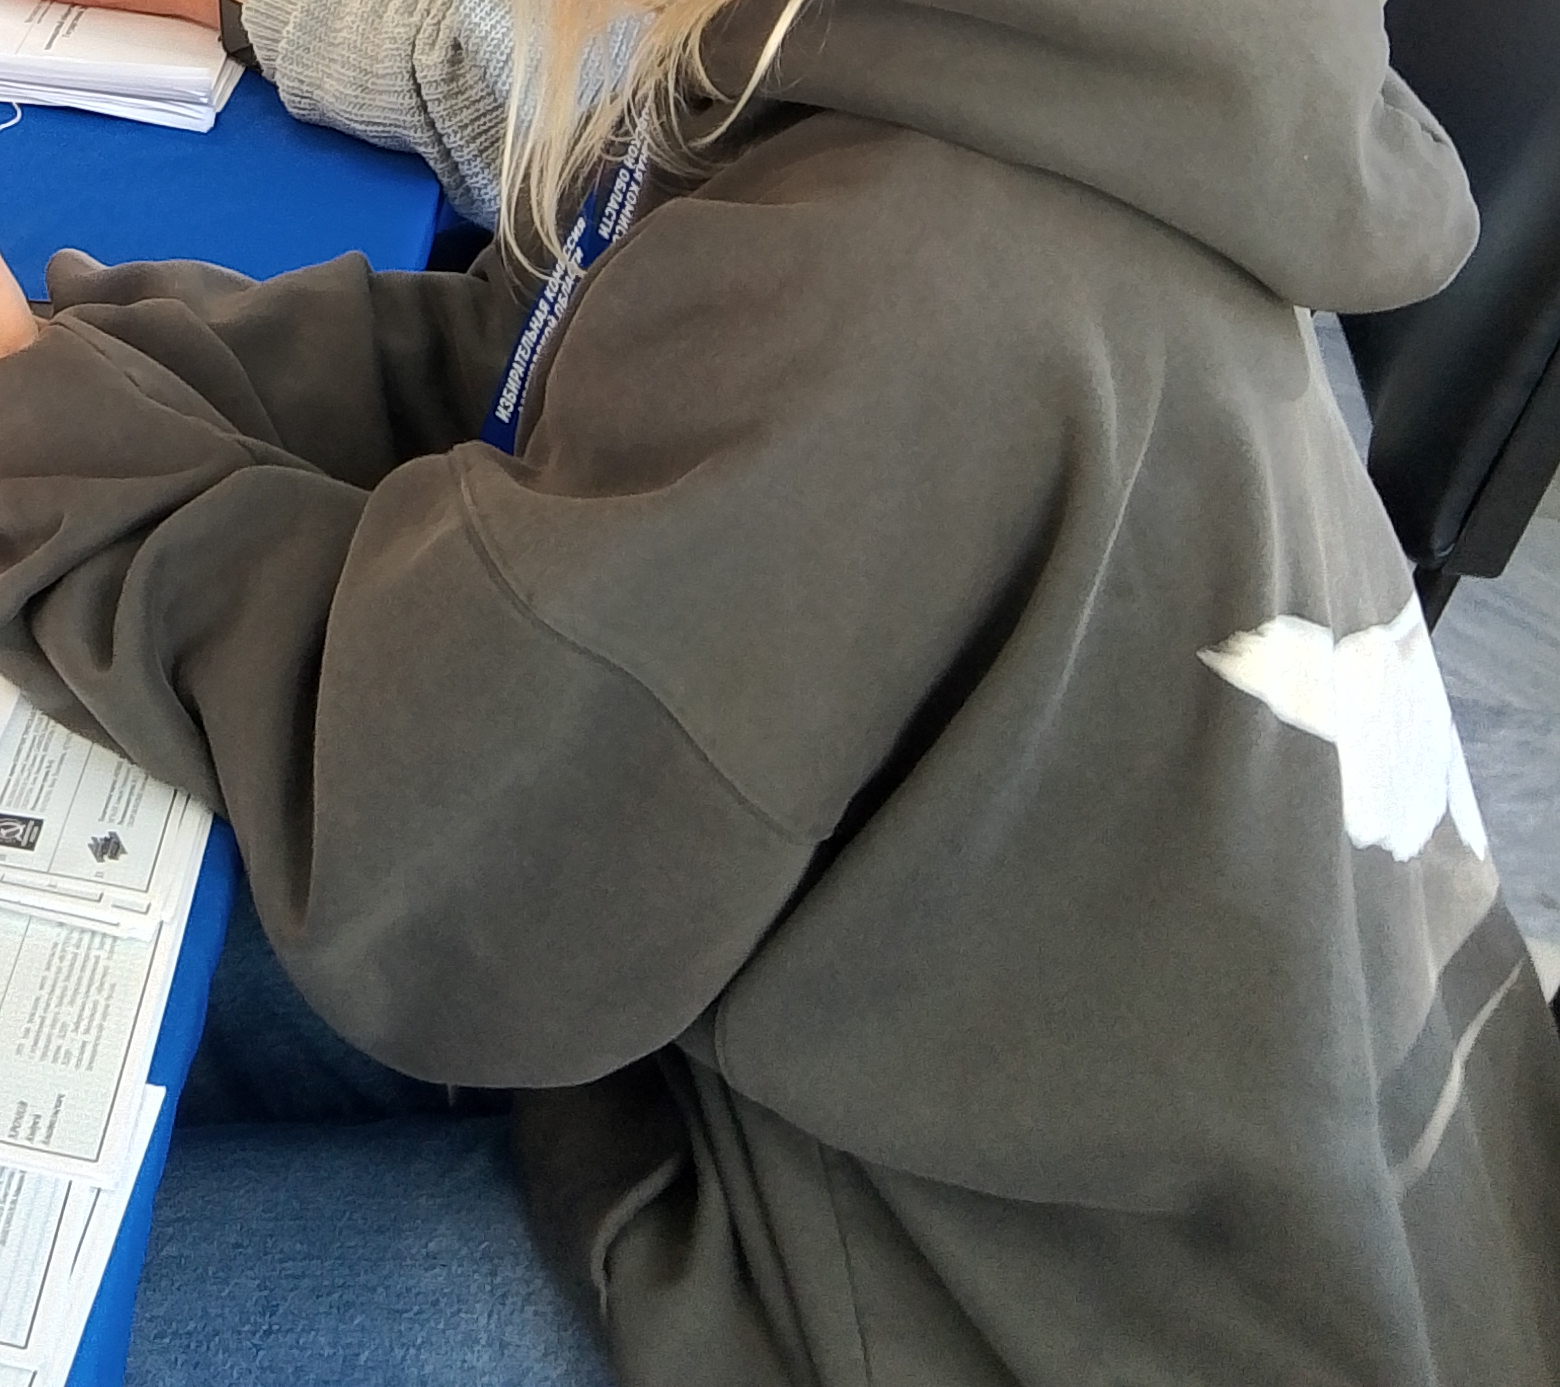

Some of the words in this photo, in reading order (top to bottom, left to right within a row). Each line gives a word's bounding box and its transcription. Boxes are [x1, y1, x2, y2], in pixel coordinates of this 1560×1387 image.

[598, 170, 631, 240] ОБЛАСТИ
[495, 298, 551, 424] ИЗБИРАТЕЛЬНАЯ
[546, 215, 587, 299] КОМССИЯ
